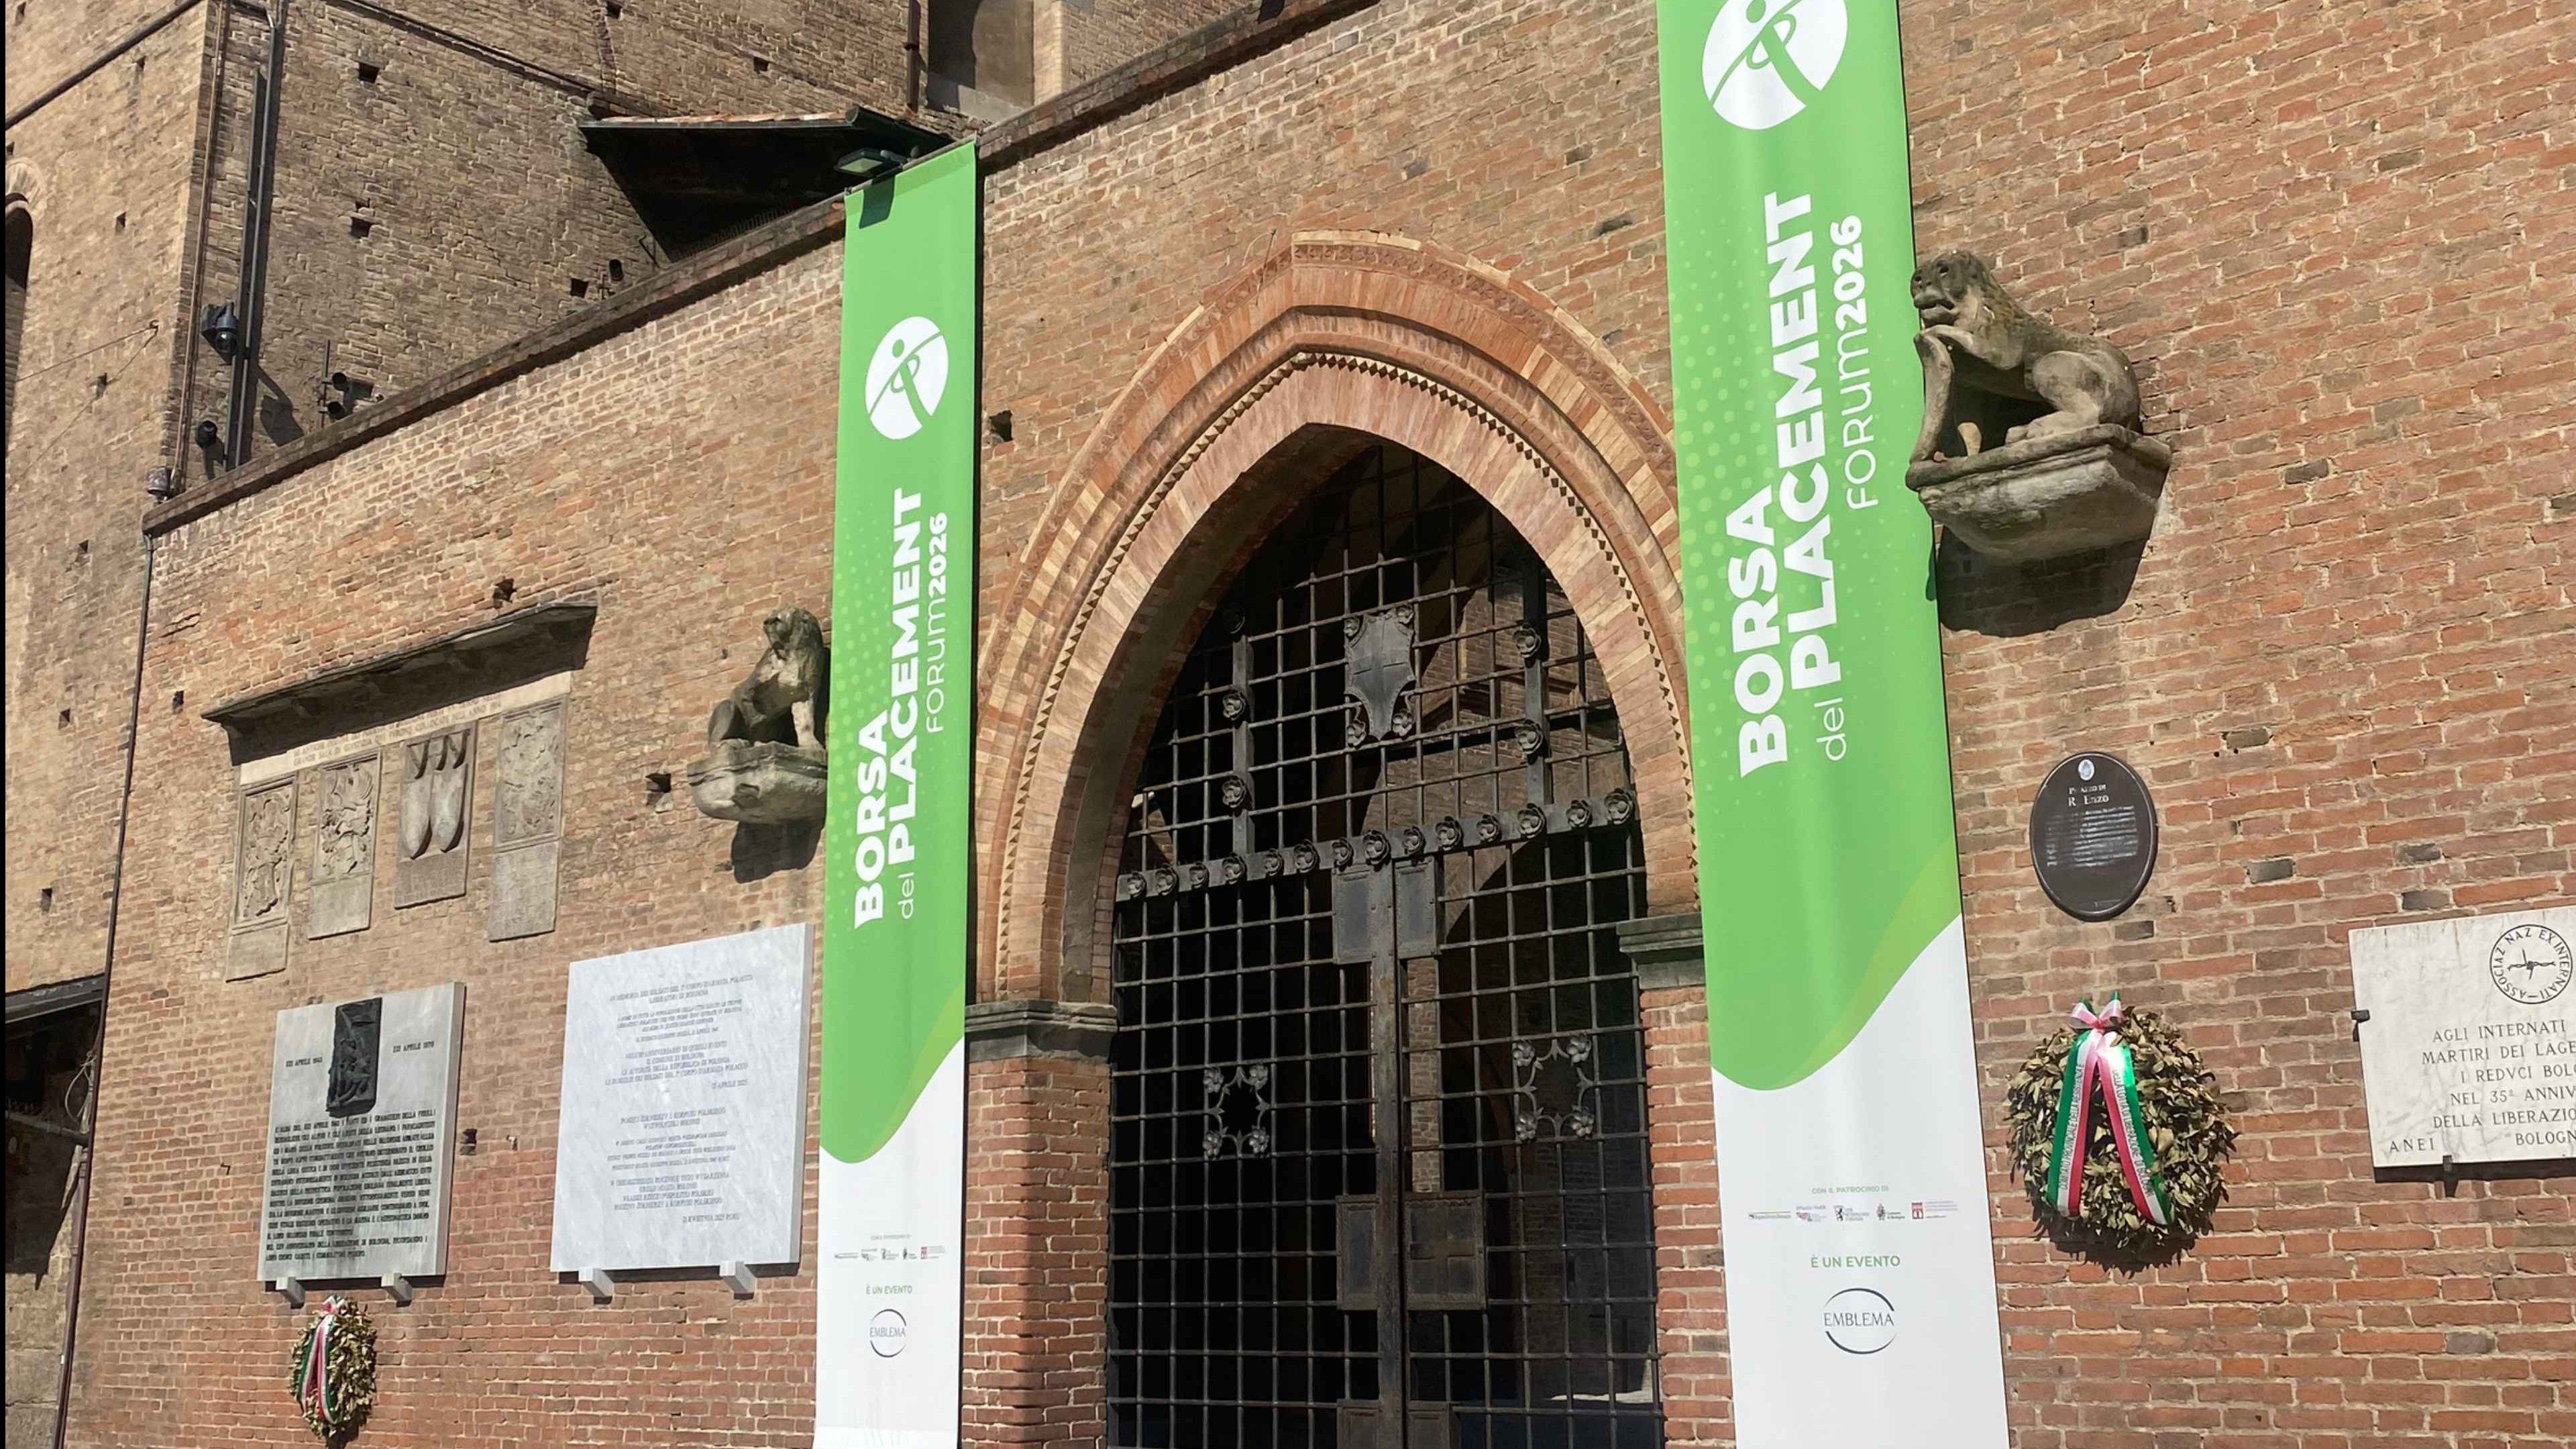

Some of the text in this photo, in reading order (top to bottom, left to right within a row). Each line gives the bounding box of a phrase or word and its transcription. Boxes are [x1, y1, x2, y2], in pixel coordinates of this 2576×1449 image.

[1764, 192, 1847, 761] del PLACEMENT
[1726, 484, 1788, 777] BORSA
[888, 488, 922, 919] del PLACEMENT
[854, 710, 888, 929] BORSA
[2493, 928, 2570, 1000] ASSOCIAZ NAZ EX INTERNATI
[2432, 1020, 2566, 1042] AGLI INTERNATI
[2422, 1041, 2576, 1065] MARTIRI DEI LAGE
[2461, 1063, 2576, 1083] I REDVCI BOL
[2451, 1092, 2480, 1106] NEL
[2524, 1085, 2576, 1102] ANNIV
[2432, 1108, 2576, 1128] DELLA LIBERAZIO
[1811, 1187, 1827, 1195] CON
[1836, 1185, 1880, 1194] PATROCINIO
[1811, 1253, 1901, 1268] È UN EVENTO
[872, 1285, 883, 1295] UN
[885, 1285, 913, 1295] EVENTO
[1824, 1311, 1895, 1327] EMBLEMA
[869, 1326, 906, 1338] EMBLEMA
